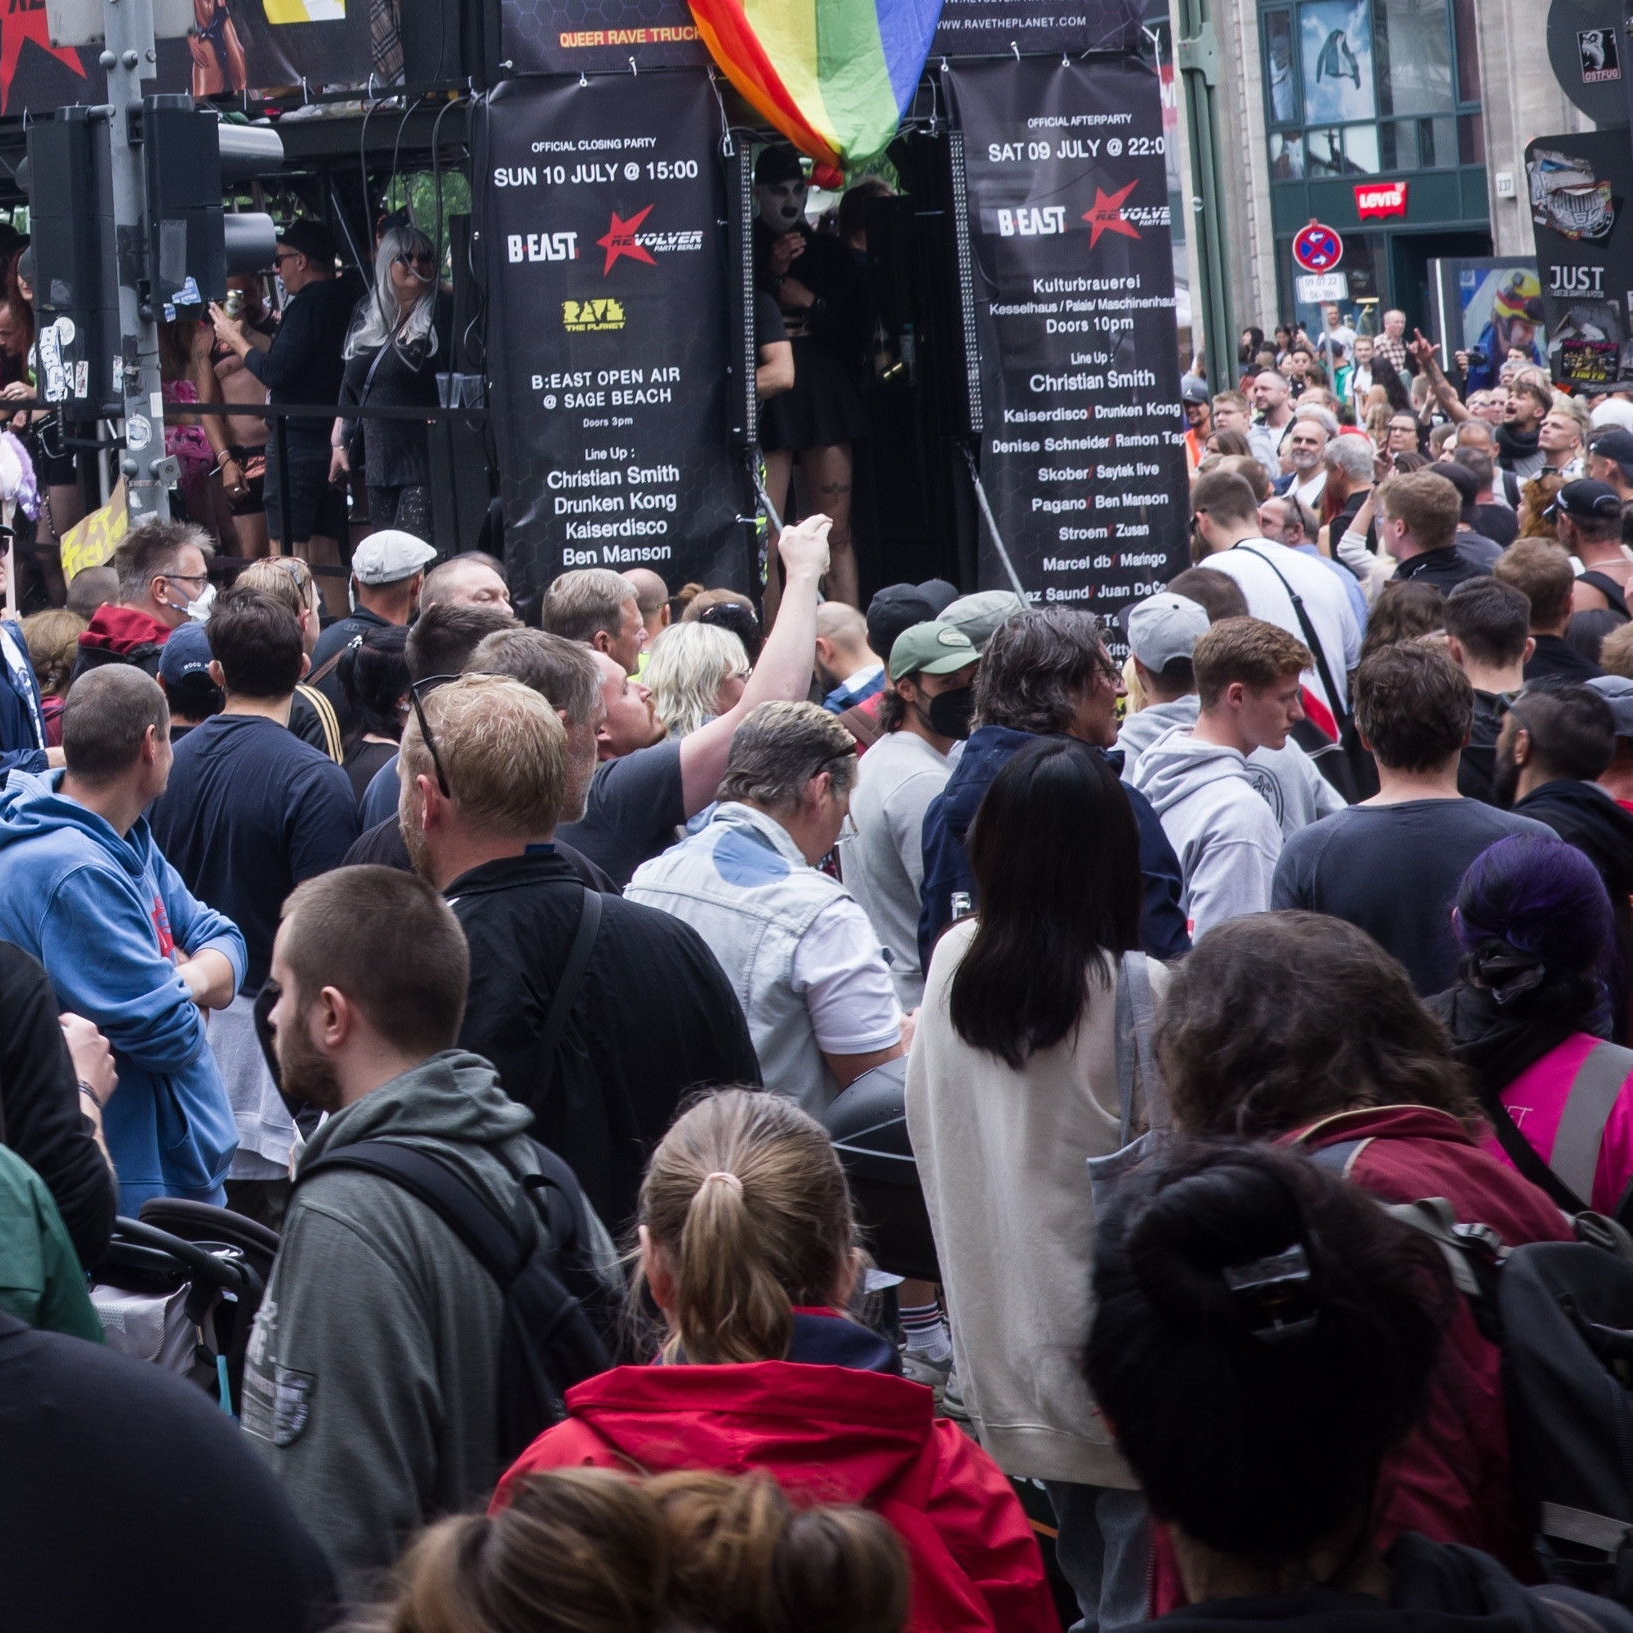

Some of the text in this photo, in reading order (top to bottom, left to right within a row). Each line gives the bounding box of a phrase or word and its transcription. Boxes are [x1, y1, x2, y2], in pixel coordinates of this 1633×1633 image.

[560, 31, 604, 50] QUEER
[608, 29, 646, 45] RAVE
[1585, 68, 1619, 81] OSTFUG
[1027, 113, 1133, 129] OFFICIAL AFTERPARTY
[531, 137, 657, 153] OFFICIAL CLOSING PARTY
[988, 137, 1124, 163] SAT 09 JULY @
[493, 160, 699, 187] SUN 10 JULY @ 15:00
[1497, 178, 1512, 192] 237
[1095, 206, 1171, 221] REVOLVE
[1139, 219, 1160, 227] PARTY
[610, 230, 704, 247] REVOLVER
[654, 243, 702, 253] PARTY BERLIN
[1033, 274, 1141, 294] Kulturbrauerei
[1550, 265, 1605, 291] JUST
[989, 302, 1058, 316] Kesselhaus
[1098, 296, 1177, 311] Maschinenhaus
[564, 321, 626, 332] THE PLANET
[1046, 317, 1134, 334] Doors 10pm
[1070, 352, 1092, 366] Line
[1093, 352, 1108, 366] Up
[531, 366, 681, 390] B:EAST OPEN AIR
[1029, 369, 1156, 393] Christian Smith
[542, 387, 672, 410] @ SAGE BEACH
[1095, 403, 1143, 419] Drunken
[1146, 402, 1181, 417] Kong
[583, 416, 634, 428] Doors 3pm
[992, 439, 1041, 454] Denise
[1116, 433, 1159, 447] Ramon
[1161, 431, 1185, 447] Tap
[585, 448, 608, 461] Line
[609, 446, 629, 462] Up
[547, 464, 681, 490] Christian Smith
[1096, 463, 1136, 481] Saytek
[1136, 462, 1160, 476] live
[554, 492, 678, 515] Drunken Kong
[1095, 495, 1120, 509] Ben
[1122, 492, 1169, 507] Manson
[566, 517, 668, 540] Kaiserdisco
[1116, 523, 1150, 538] Zusan
[563, 545, 672, 566] Ben Manson
[1043, 555, 1090, 572] Marcel
[1120, 551, 1167, 568] Maringo
[1097, 583, 1130, 598] Juan
